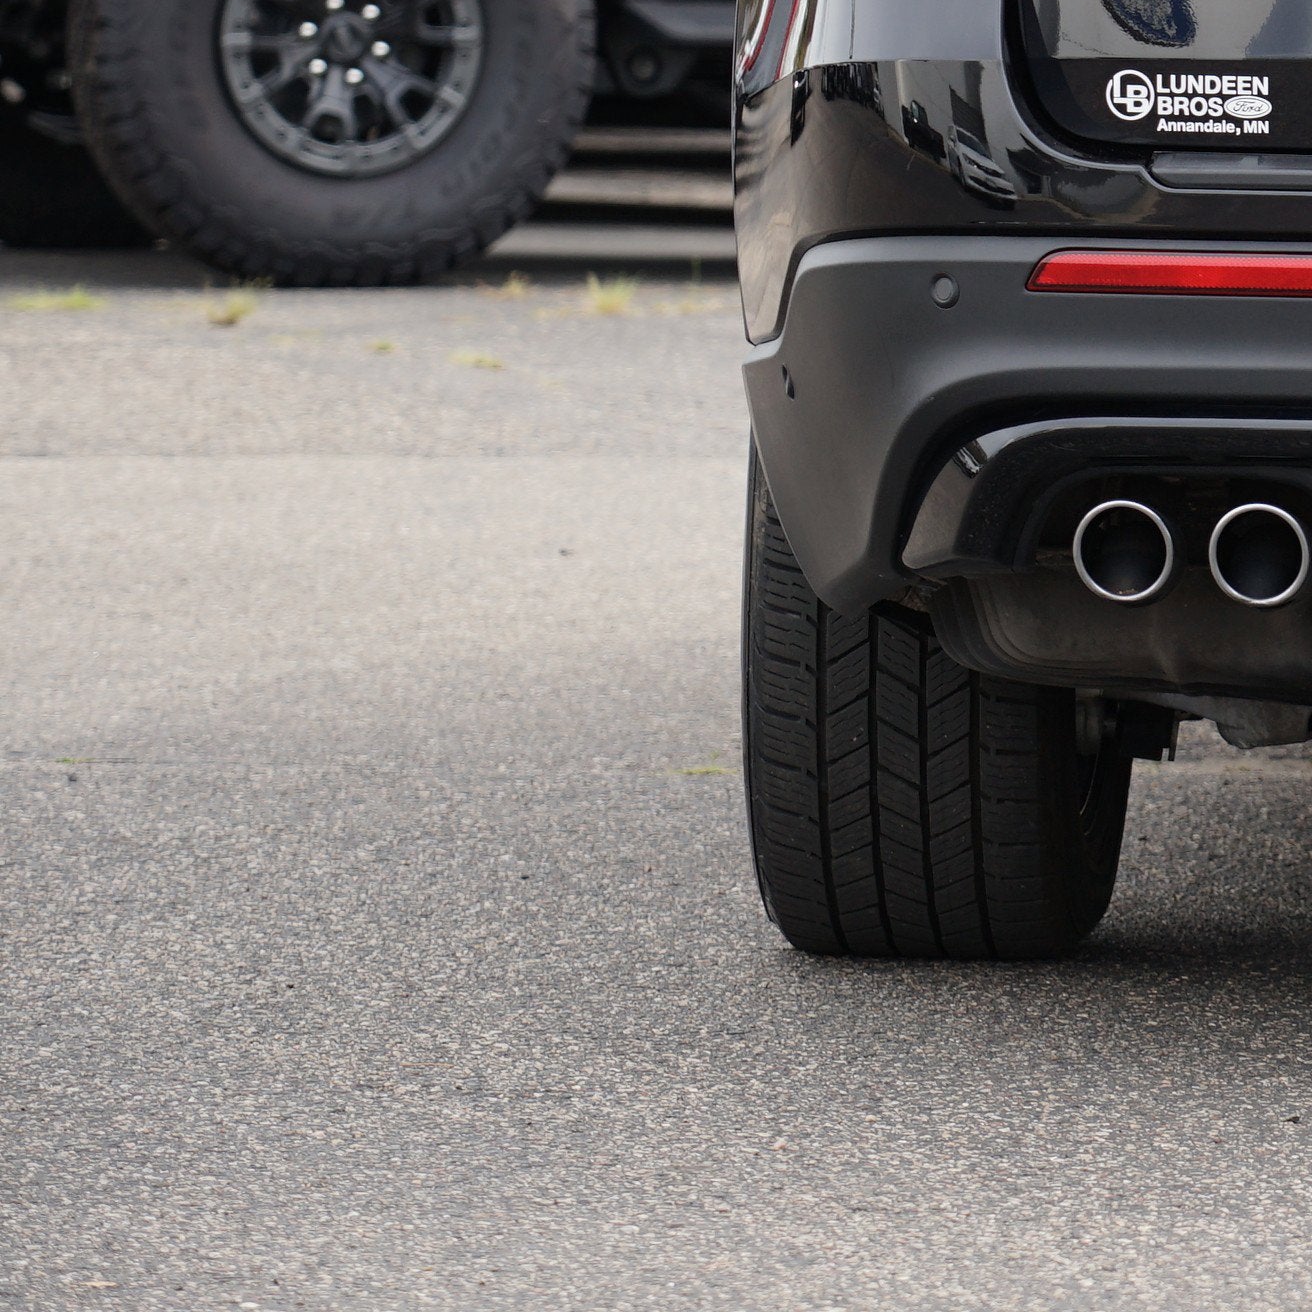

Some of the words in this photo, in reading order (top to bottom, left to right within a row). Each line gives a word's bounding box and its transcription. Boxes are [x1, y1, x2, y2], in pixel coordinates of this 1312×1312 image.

[1156, 74, 1269, 96] LUNDEEN
[1157, 97, 1223, 117] BROS
[1157, 119, 1241, 135] Annandale,
[1243, 121, 1270, 134] MN
